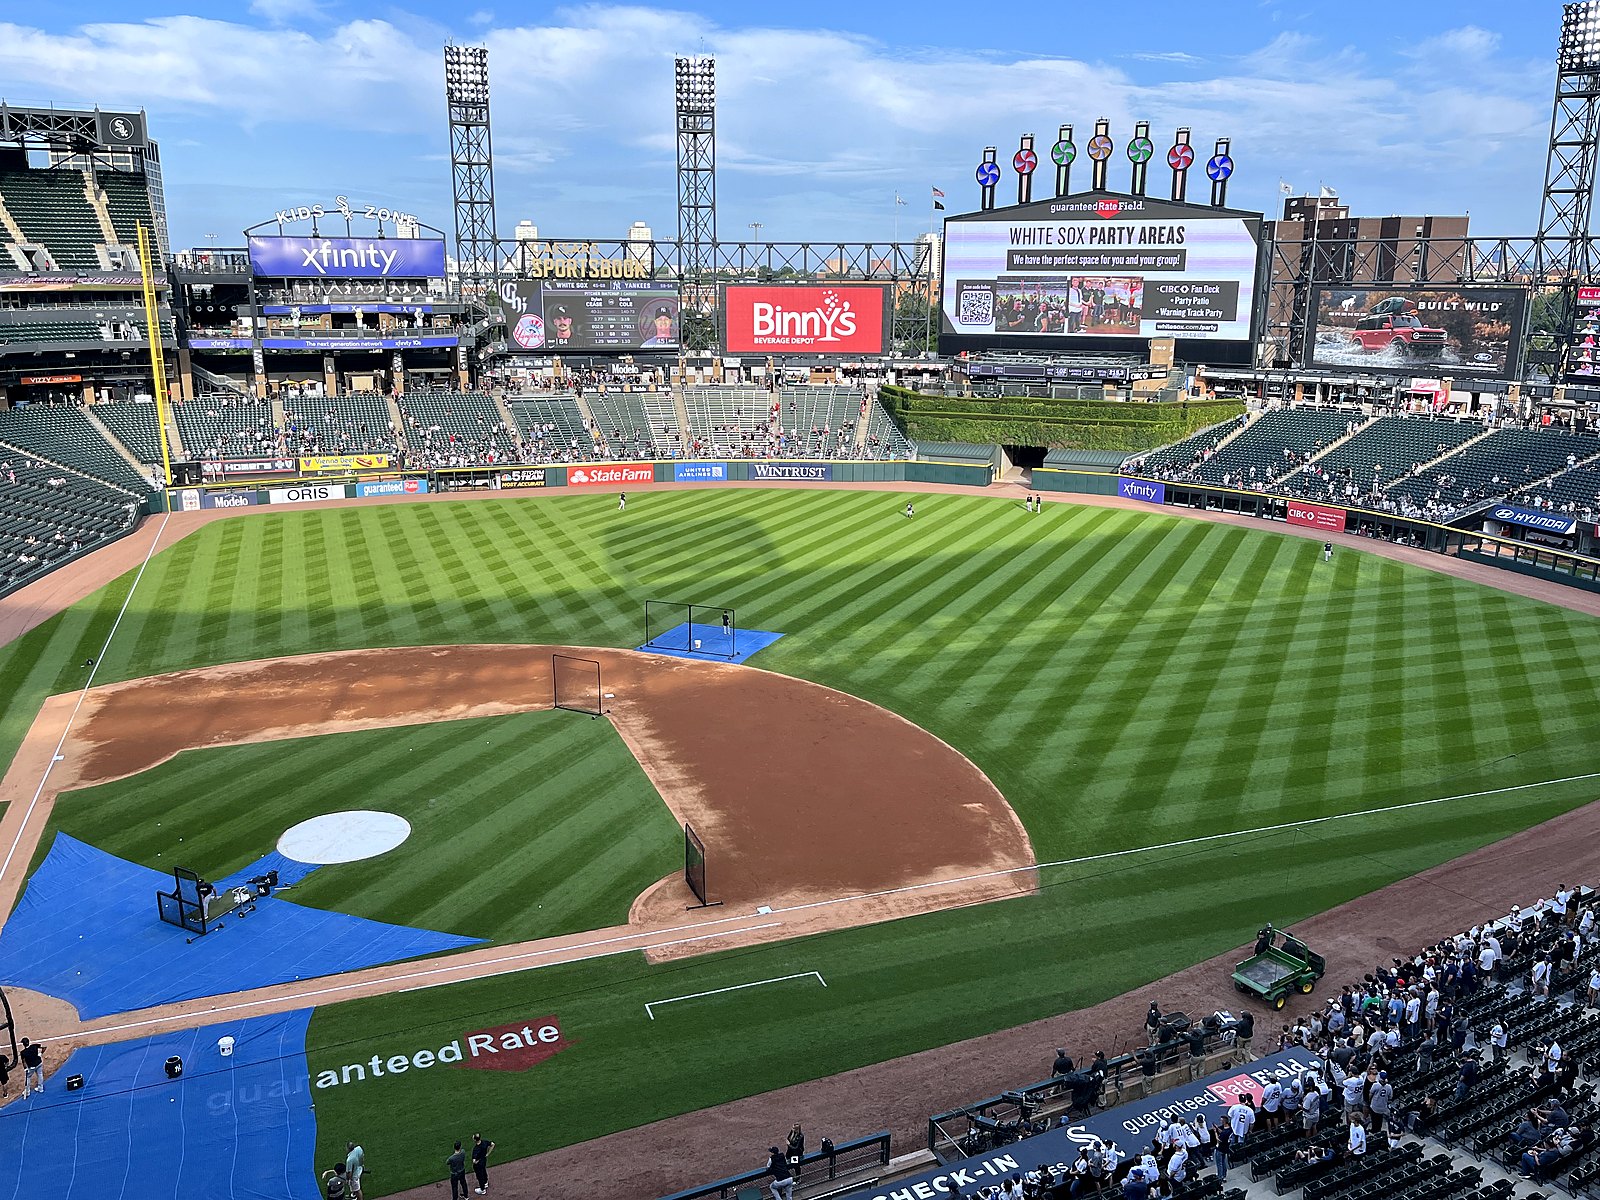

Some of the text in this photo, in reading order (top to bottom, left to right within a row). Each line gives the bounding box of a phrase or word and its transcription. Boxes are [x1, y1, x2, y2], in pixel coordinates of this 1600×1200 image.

[1050, 202, 1098, 213] guaranteed
[1098, 202, 1117, 211] Rate
[275, 204, 325, 224] KIDS
[364, 205, 418, 228] ZONE
[1010, 226, 1186, 245] WHITE SOX PARTY AREAS
[529, 243, 599, 254] CAESARS
[301, 240, 398, 275] xfinity
[1013, 255, 1180, 267] We have the perfect space for you and your group!
[531, 258, 647, 279] SPORTSBOOK
[1160, 285, 1219, 293] CIBC Fan Deck
[1174, 296, 1209, 306] Party Patio
[1418, 301, 1459, 310] BUILT
[1160, 307, 1223, 318] Warning Track Party
[791, 337, 814, 345] DEPOT
[611, 364, 639, 374] Modelo
[315, 457, 338, 465] Vienna
[511, 471, 521, 481] 5
[754, 464, 826, 478] WINTRUST
[287, 487, 329, 500] ORIS
[363, 482, 403, 496] guaranteed
[1123, 482, 1156, 499] xfinity
[214, 495, 248, 508] Modelo
[1288, 509, 1307, 519] CIBC
[1513, 513, 1568, 530] HYUNDAI
[467, 1023, 560, 1058] Rate
[1121, 1088, 1219, 1135] guaranteed
[1215, 1078, 1258, 1101] Rate
[1238, 1114, 1246, 1123] 2
